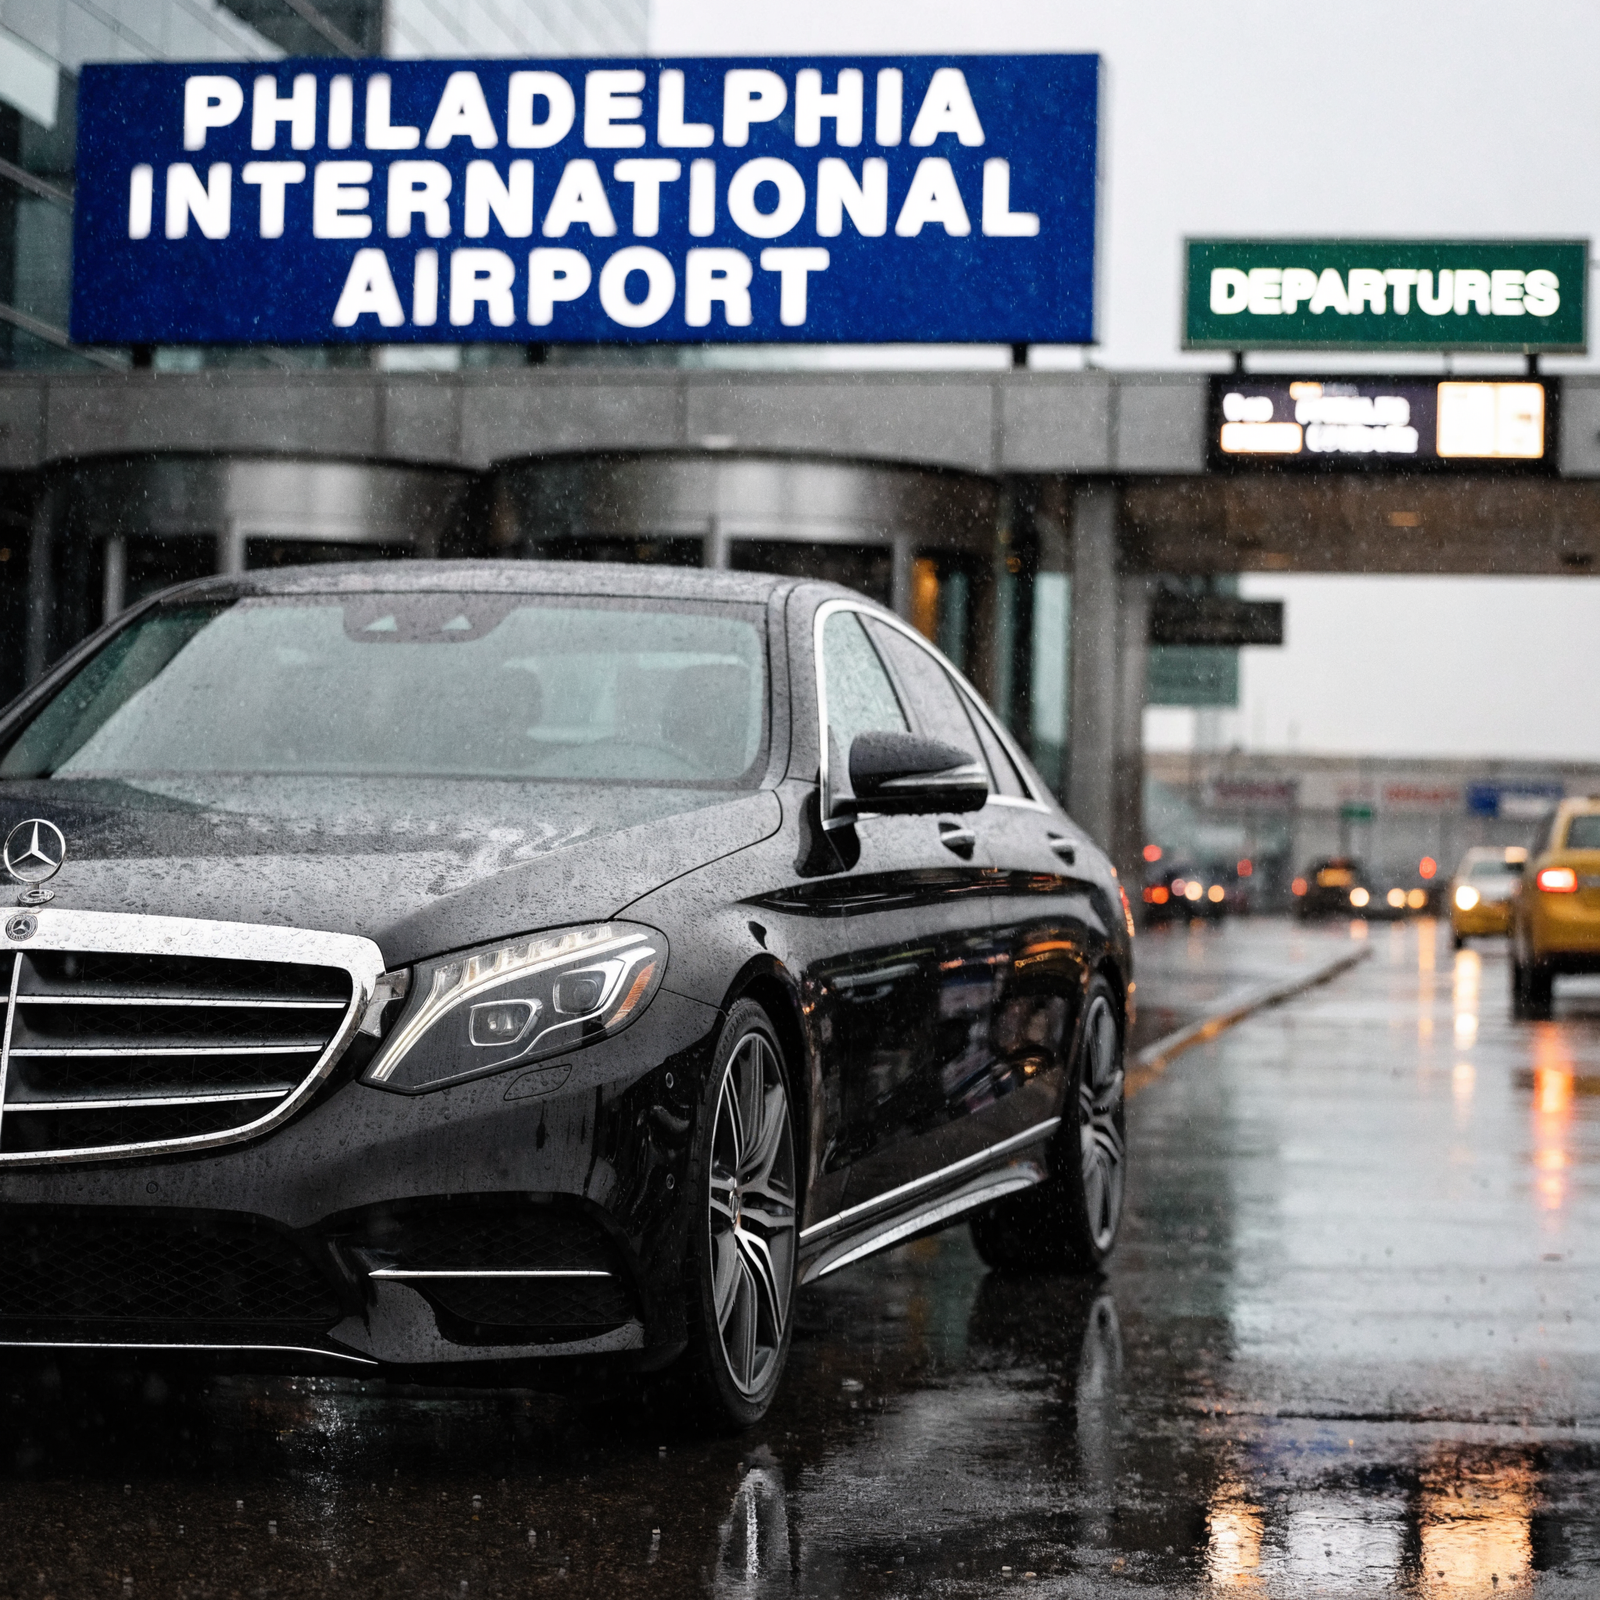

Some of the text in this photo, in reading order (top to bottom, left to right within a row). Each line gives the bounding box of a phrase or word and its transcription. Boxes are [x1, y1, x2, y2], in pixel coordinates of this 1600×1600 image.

[182, 67, 986, 152] PHILADELPHIA
[128, 156, 1041, 241] INTERNATIONAL
[332, 245, 830, 329] AIRPORT
[1209, 266, 1561, 317] DEPARTURES
